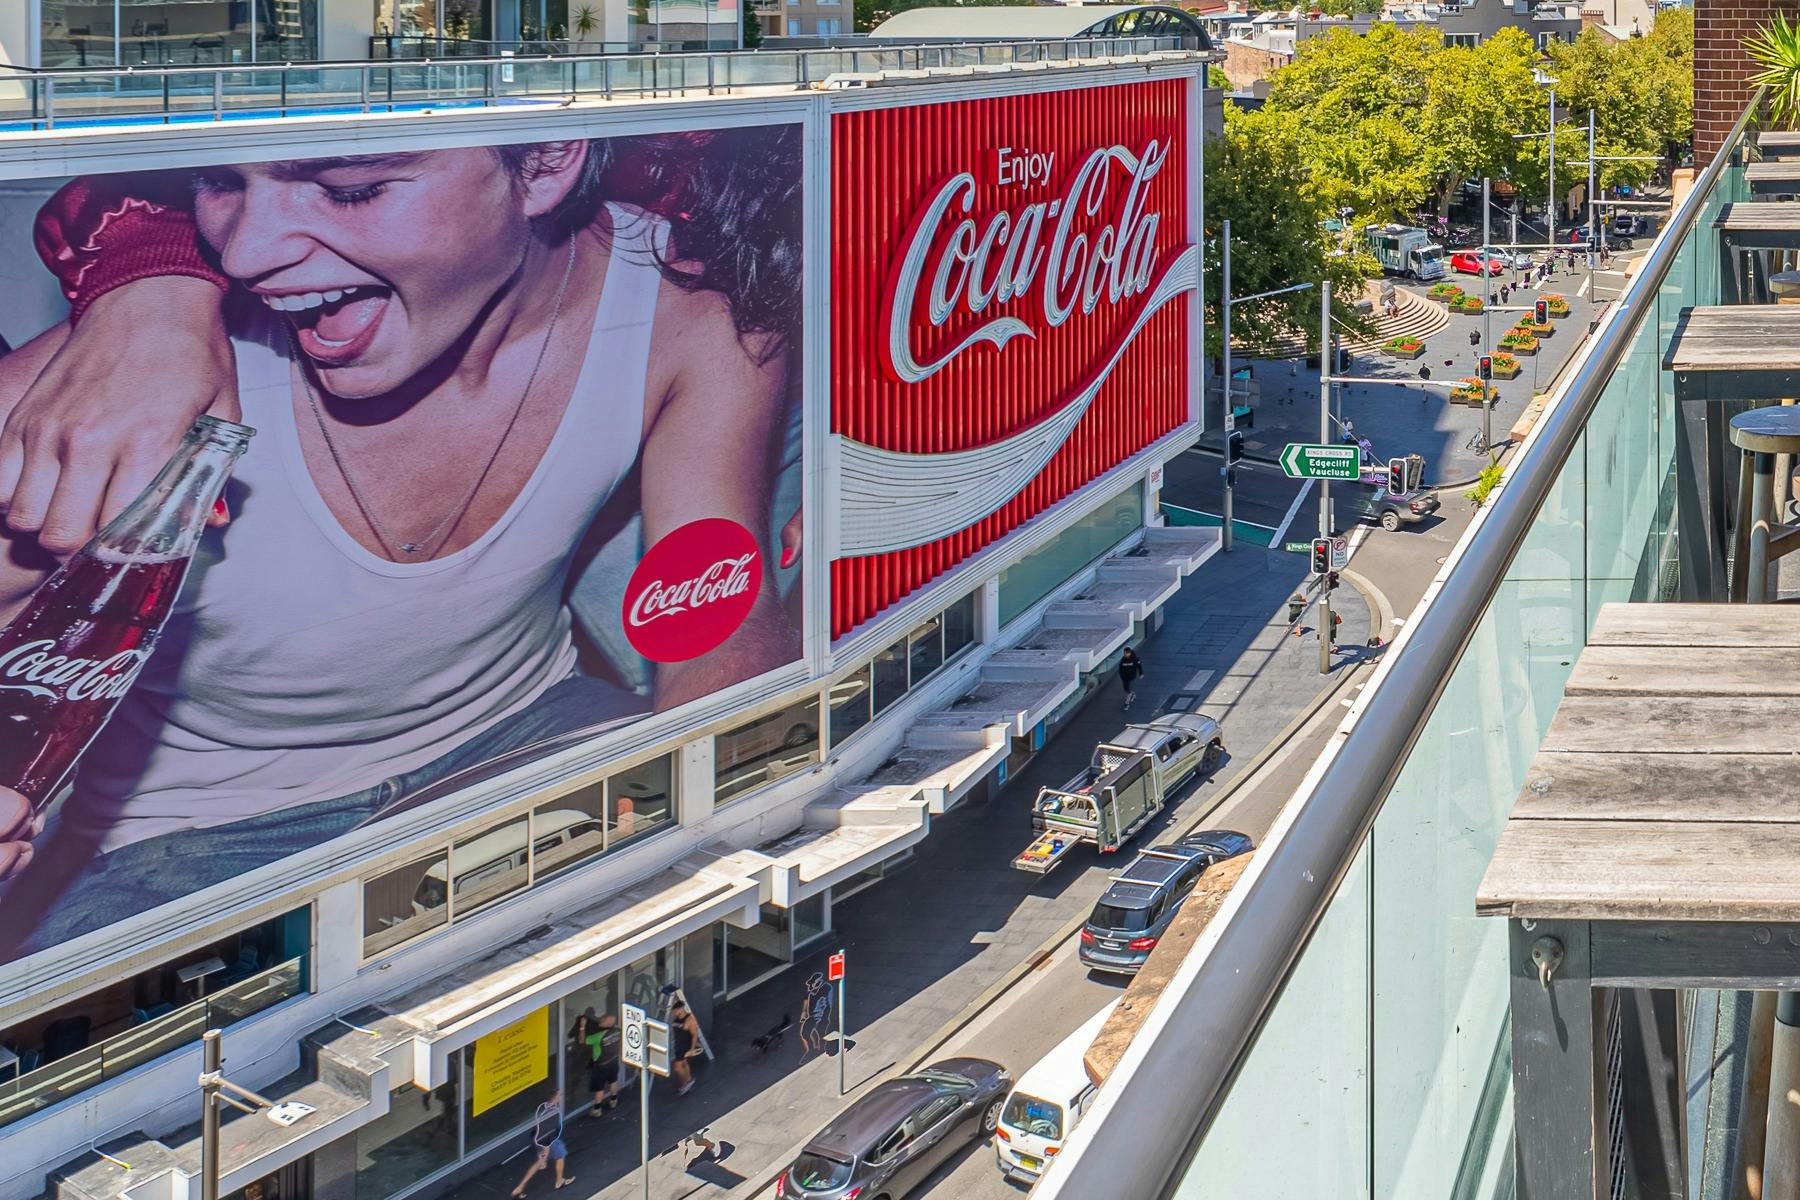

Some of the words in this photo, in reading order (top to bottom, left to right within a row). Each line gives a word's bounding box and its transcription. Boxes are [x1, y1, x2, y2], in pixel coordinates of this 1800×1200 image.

[998, 147, 1055, 190] Enjoy
[888, 135, 1172, 384] Coca-Cola
[1309, 458, 1350, 469] Edgecliff
[1309, 467, 1351, 477] Vaucluse
[629, 551, 757, 627] Coca-Cola
[626, 1008, 642, 1023] END
[628, 1029, 640, 1044] 40
[626, 1050, 642, 1062] AREA
